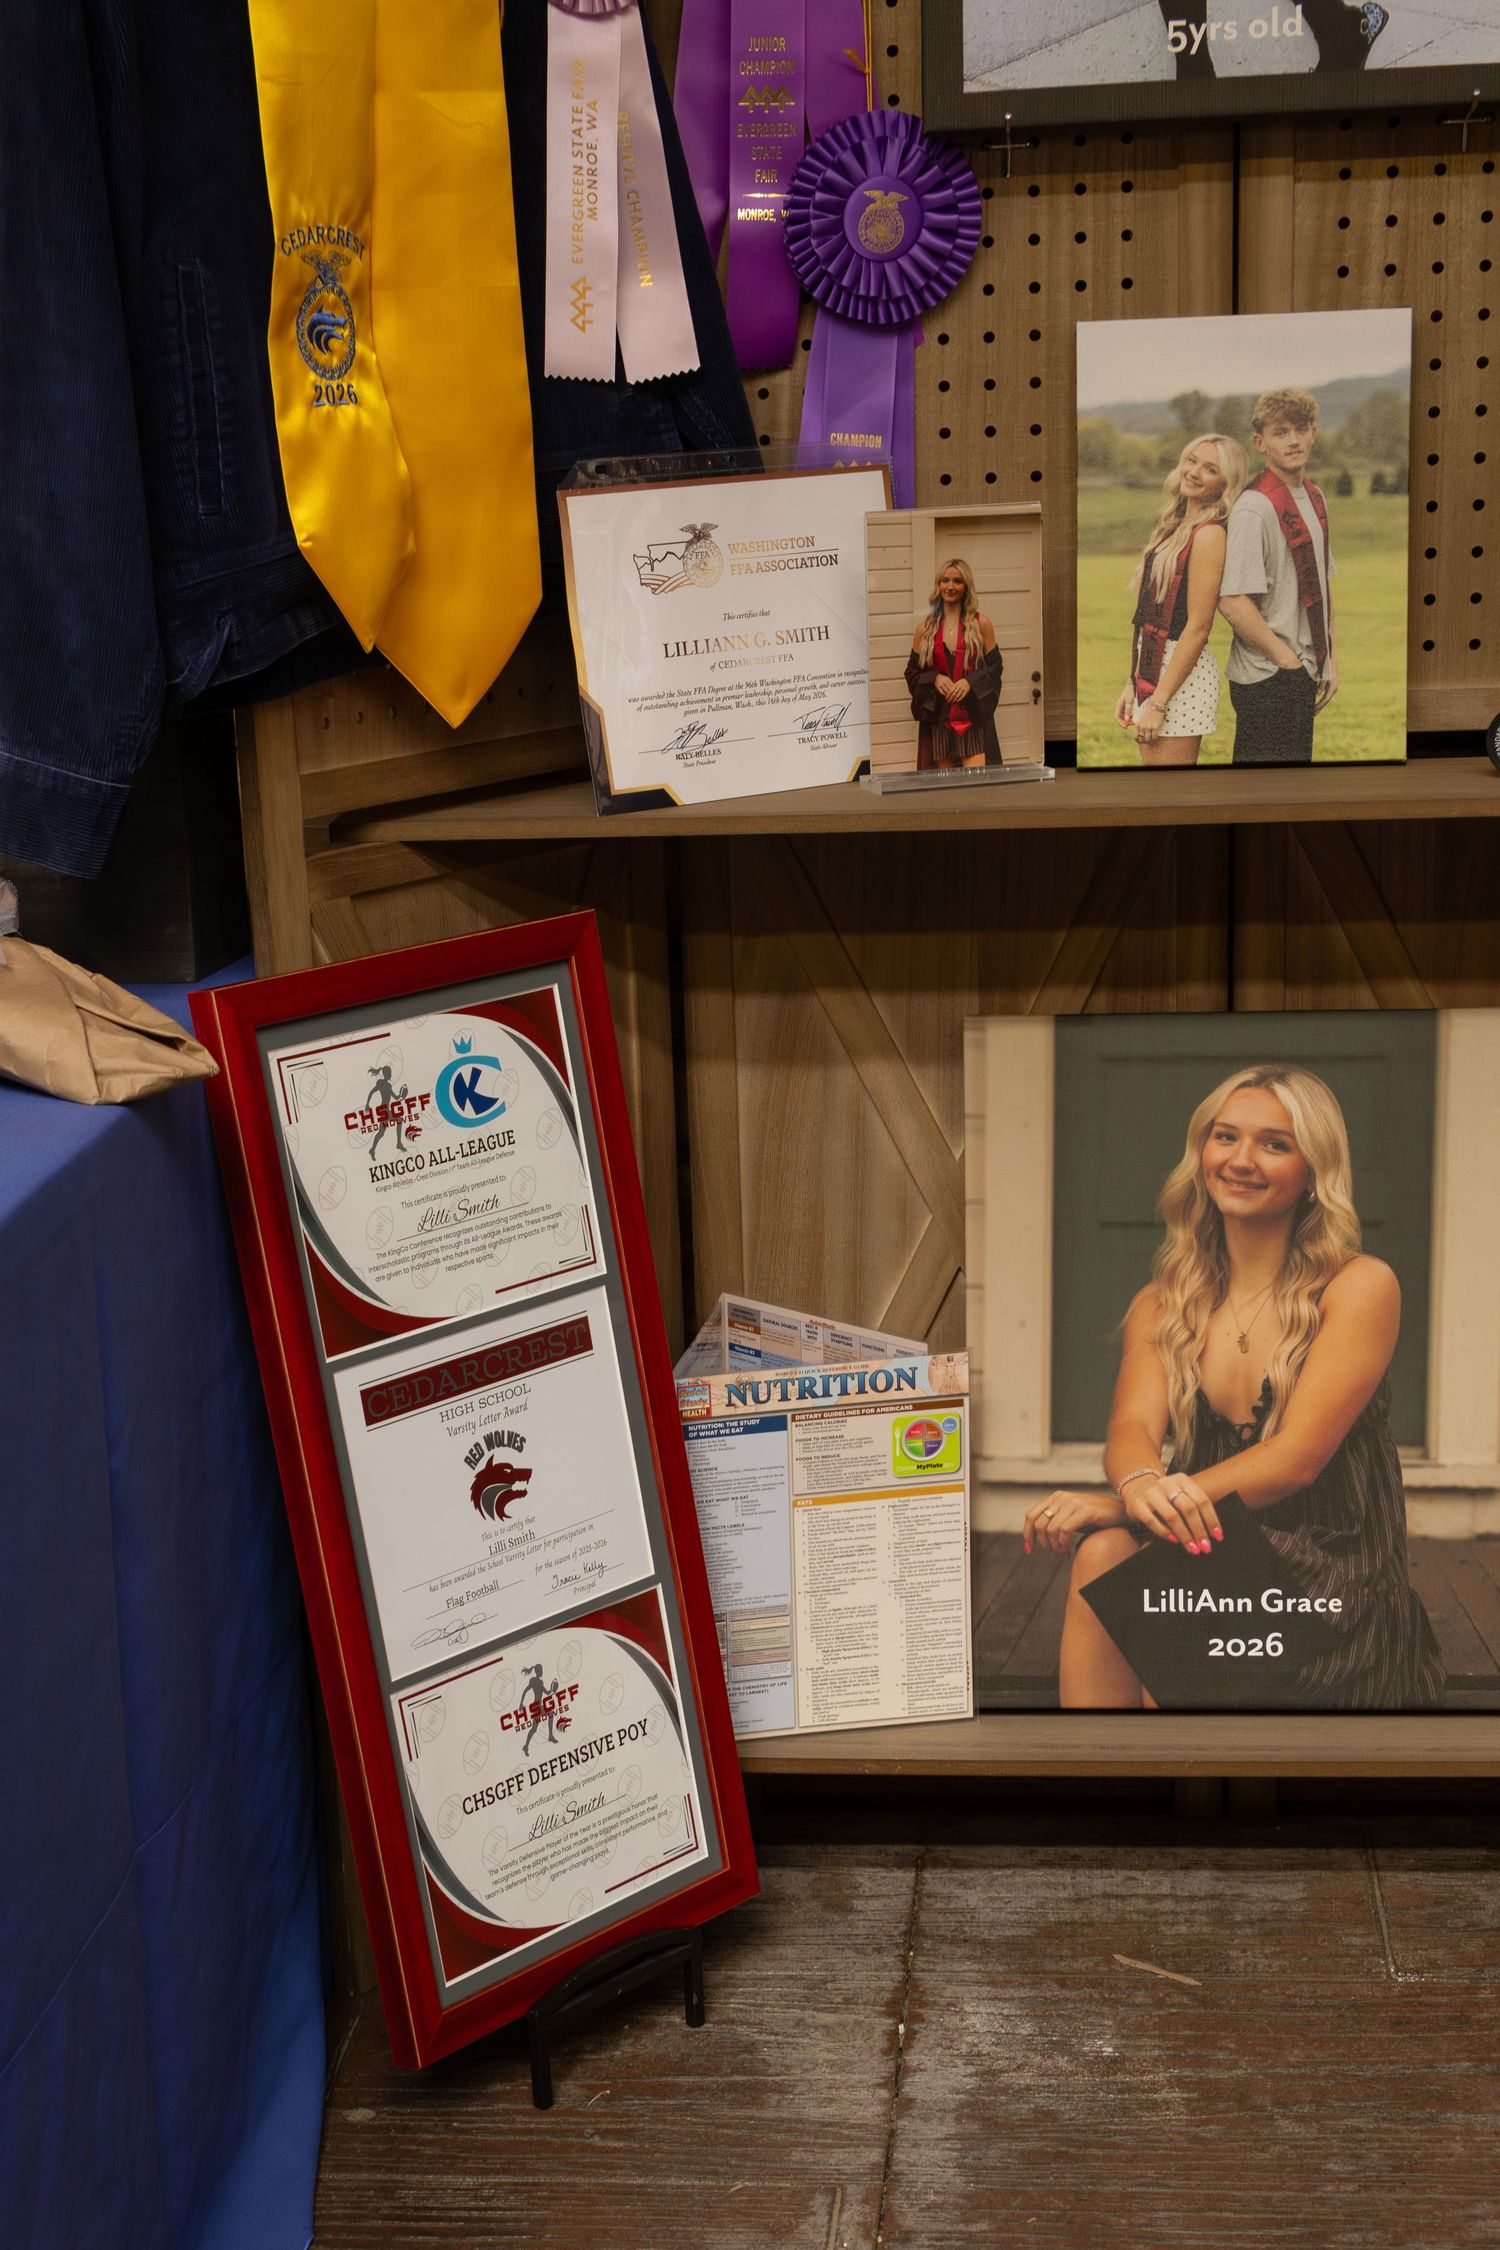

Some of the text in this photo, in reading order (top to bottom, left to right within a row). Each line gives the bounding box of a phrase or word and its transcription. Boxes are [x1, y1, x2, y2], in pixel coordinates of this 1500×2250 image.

[748, 36, 786, 52] JUNIOR
[1168, 6, 1304, 55] 5yrs old
[739, 60, 794, 76] CHAMPION
[737, 122, 796, 138] EVERGREEN
[572, 58, 586, 264] EVERGREEN STATE FAIR
[586, 100, 598, 221] MONROE, WA
[751, 146, 782, 160] STATE
[755, 168, 778, 183] FAIR
[738, 208, 790, 222] MONROE, W
[281, 224, 365, 260] CEDARCREST
[626, 191, 654, 288] CHAMPION
[314, 383, 358, 406] 2026
[830, 432, 882, 448] CHAMPION
[695, 551, 710, 559] FFA
[728, 536, 814, 554] WASHINGTON
[730, 554, 839, 575] FFA ASSOCIATION
[722, 608, 770, 620] This certifies that
[663, 624, 830, 658] LILLIANN G. SMITH
[709, 653, 793, 671] of CEDARCREST FFA
[797, 731, 848, 744] TRACY POWELL
[675, 748, 721, 760] KATY BELLES
[344, 1093, 431, 1130] CHSGFF
[360, 1112, 420, 1135] RED WOLVES
[369, 1130, 515, 1183] KINGCO ALL-LEAGUE
[400, 1200, 413, 1208] This
[413, 1192, 442, 1205] certificate
[448, 1184, 470, 1197] proudly
[470, 1175, 498, 1191] presented
[417, 1194, 500, 1232] Lilli Smith
[367, 1256, 410, 1272] interscholastic
[411, 1248, 439, 1261] programs
[439, 1239, 463, 1251] through
[471, 1229, 501, 1242] All-League
[524, 1218, 541, 1226] These
[541, 1211, 562, 1221] awards
[387, 1245, 408, 1255] KingCo
[408, 1235, 442, 1249] Conference
[443, 1226, 473, 1239] recognizes
[474, 1216, 508, 1230] outstanding
[508, 1206, 544, 1220] contributions
[386, 1269, 402, 1280] given
[410, 1257, 440, 1271] individuals
[442, 1253, 454, 1261] who
[454, 1249, 469, 1258] have
[469, 1244, 487, 1253] made
[487, 1234, 516, 1248] significant
[517, 1228, 540, 1239] impacts
[546, 1222, 559, 1230] their
[445, 1259, 475, 1271] respective
[367, 1324, 587, 1418] CEDARCREST
[725, 1366, 918, 1407] NUTRITION
[439, 1381, 532, 1422] HIGH SCHOOL
[682, 1409, 706, 1418] HEALTH
[795, 1412, 823, 1420] DIETARY
[822, 1409, 860, 1418] GUIDELINES
[875, 1404, 913, 1412] AMERICANS
[446, 1399, 528, 1438] Varsity Letter Award
[688, 1421, 725, 1431] NUTRITION:
[464, 1430, 526, 1470] RED WOLVES
[481, 1531, 492, 1541] This
[506, 1520, 524, 1532] certify
[523, 1514, 535, 1525] that
[488, 1528, 535, 1555] Lilli Smith
[445, 1579, 499, 1608] Flag Football
[573, 1580, 596, 1596] Principal
[1144, 1588, 1342, 1613] LilliAnn Grace
[1208, 1632, 1283, 1656] 2026
[500, 1684, 580, 1731] CHSGFF
[514, 1704, 570, 1734] RED WOLVES
[461, 1717, 650, 1816] CHSGFF DEFENSIVE POY
[516, 1805, 528, 1815] This
[528, 1793, 555, 1809] certificate
[560, 1781, 580, 1796] proudly
[581, 1767, 608, 1787] presented
[529, 1792, 606, 1841] Lilli Smith
[488, 1867, 499, 1876] The
[499, 1858, 518, 1871] Varsity
[518, 1846, 545, 1862] Defensive
[545, 1838, 562, 1850] Player
[562, 1833, 569, 1842] of
[568, 1830, 578, 1839] the
[579, 1825, 591, 1834] Year
[601, 1806, 630, 1825] prestigious
[630, 1799, 646, 1810] honor
[646, 1792, 658, 1803] that
[550, 1856, 594, 1881] game-changing
